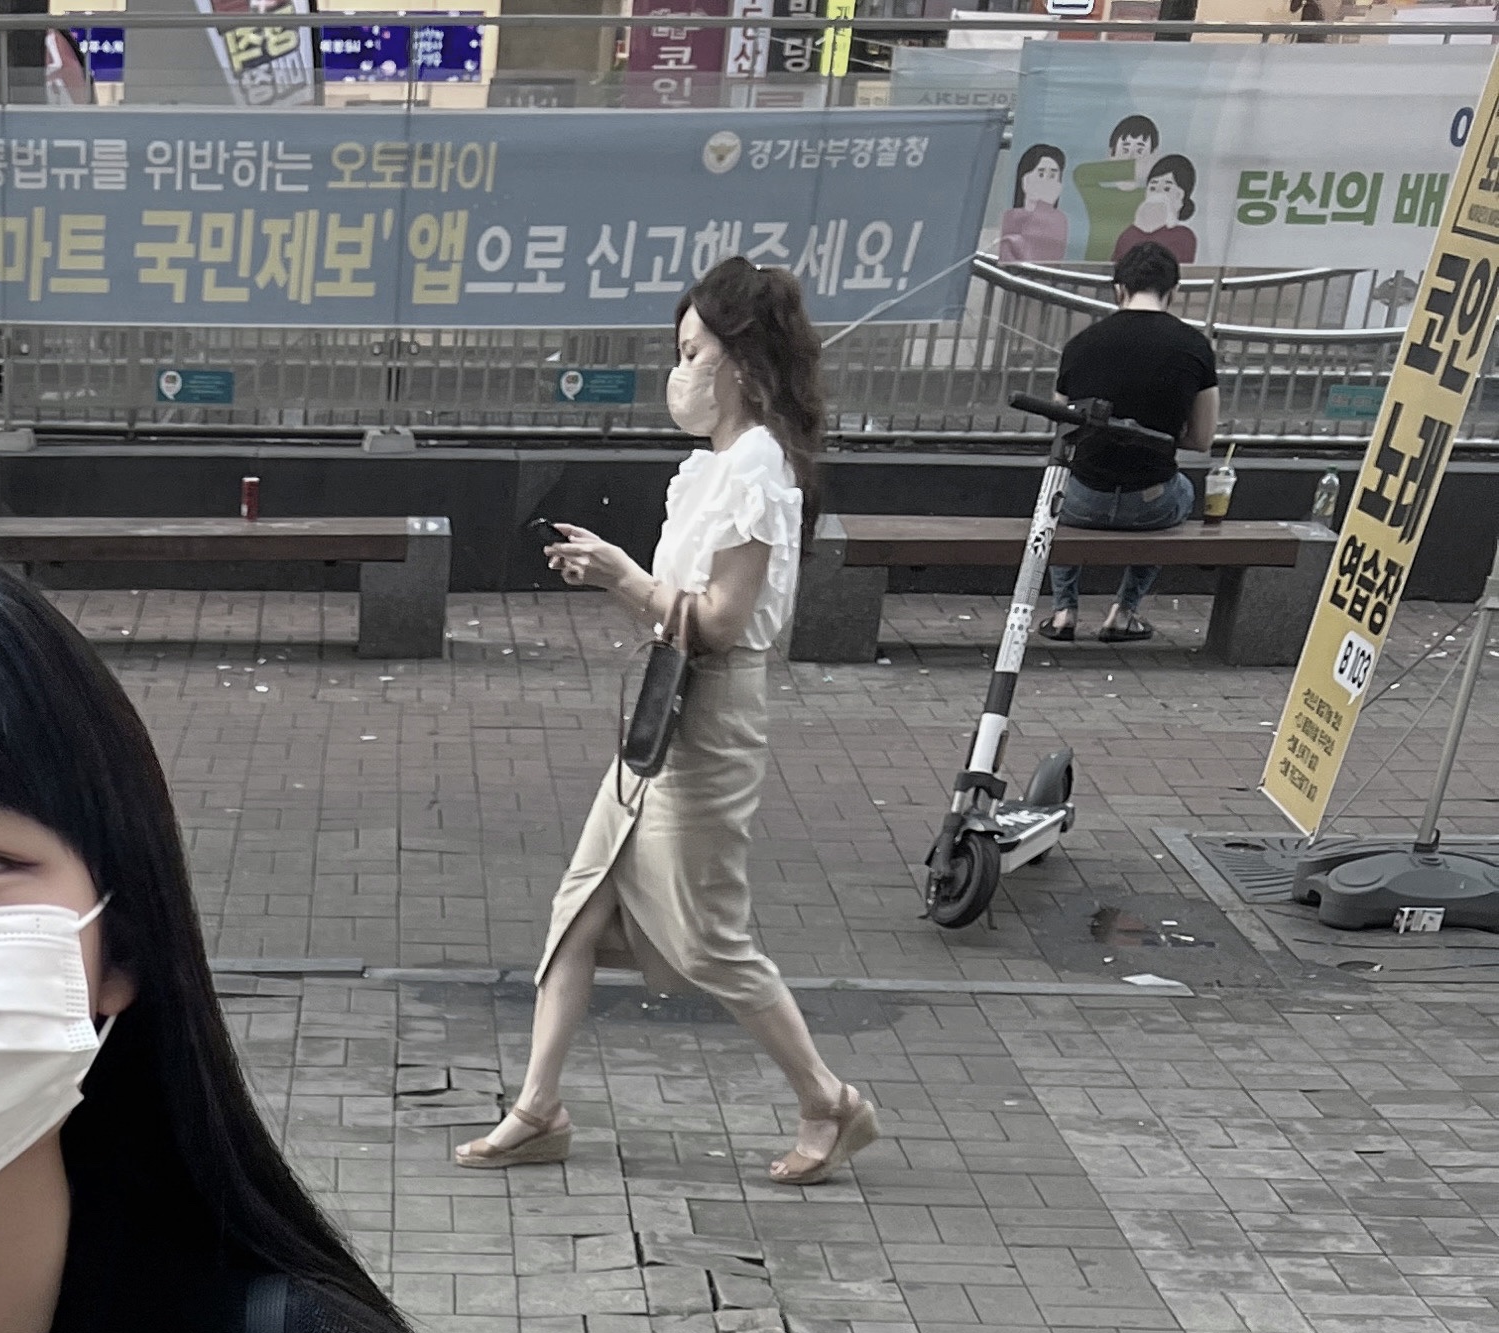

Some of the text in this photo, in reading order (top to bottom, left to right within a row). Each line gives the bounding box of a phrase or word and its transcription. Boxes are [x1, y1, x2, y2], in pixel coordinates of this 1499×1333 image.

[144, 139, 313, 192] 위반하는
[326, 140, 499, 194] 오토바이
[748, 135, 929, 169] 경기남부경찰청
[1237, 170, 1450, 228] 당신의 배
[134, 207, 395, 304] 국민제보'
[408, 209, 568, 304] 앱으로
[586, 218, 924, 298] 신고해주세요!
[1404, 253, 1499, 395] 코인
[1357, 402, 1453, 545] 노래
[1329, 534, 1405, 637] 연습장
